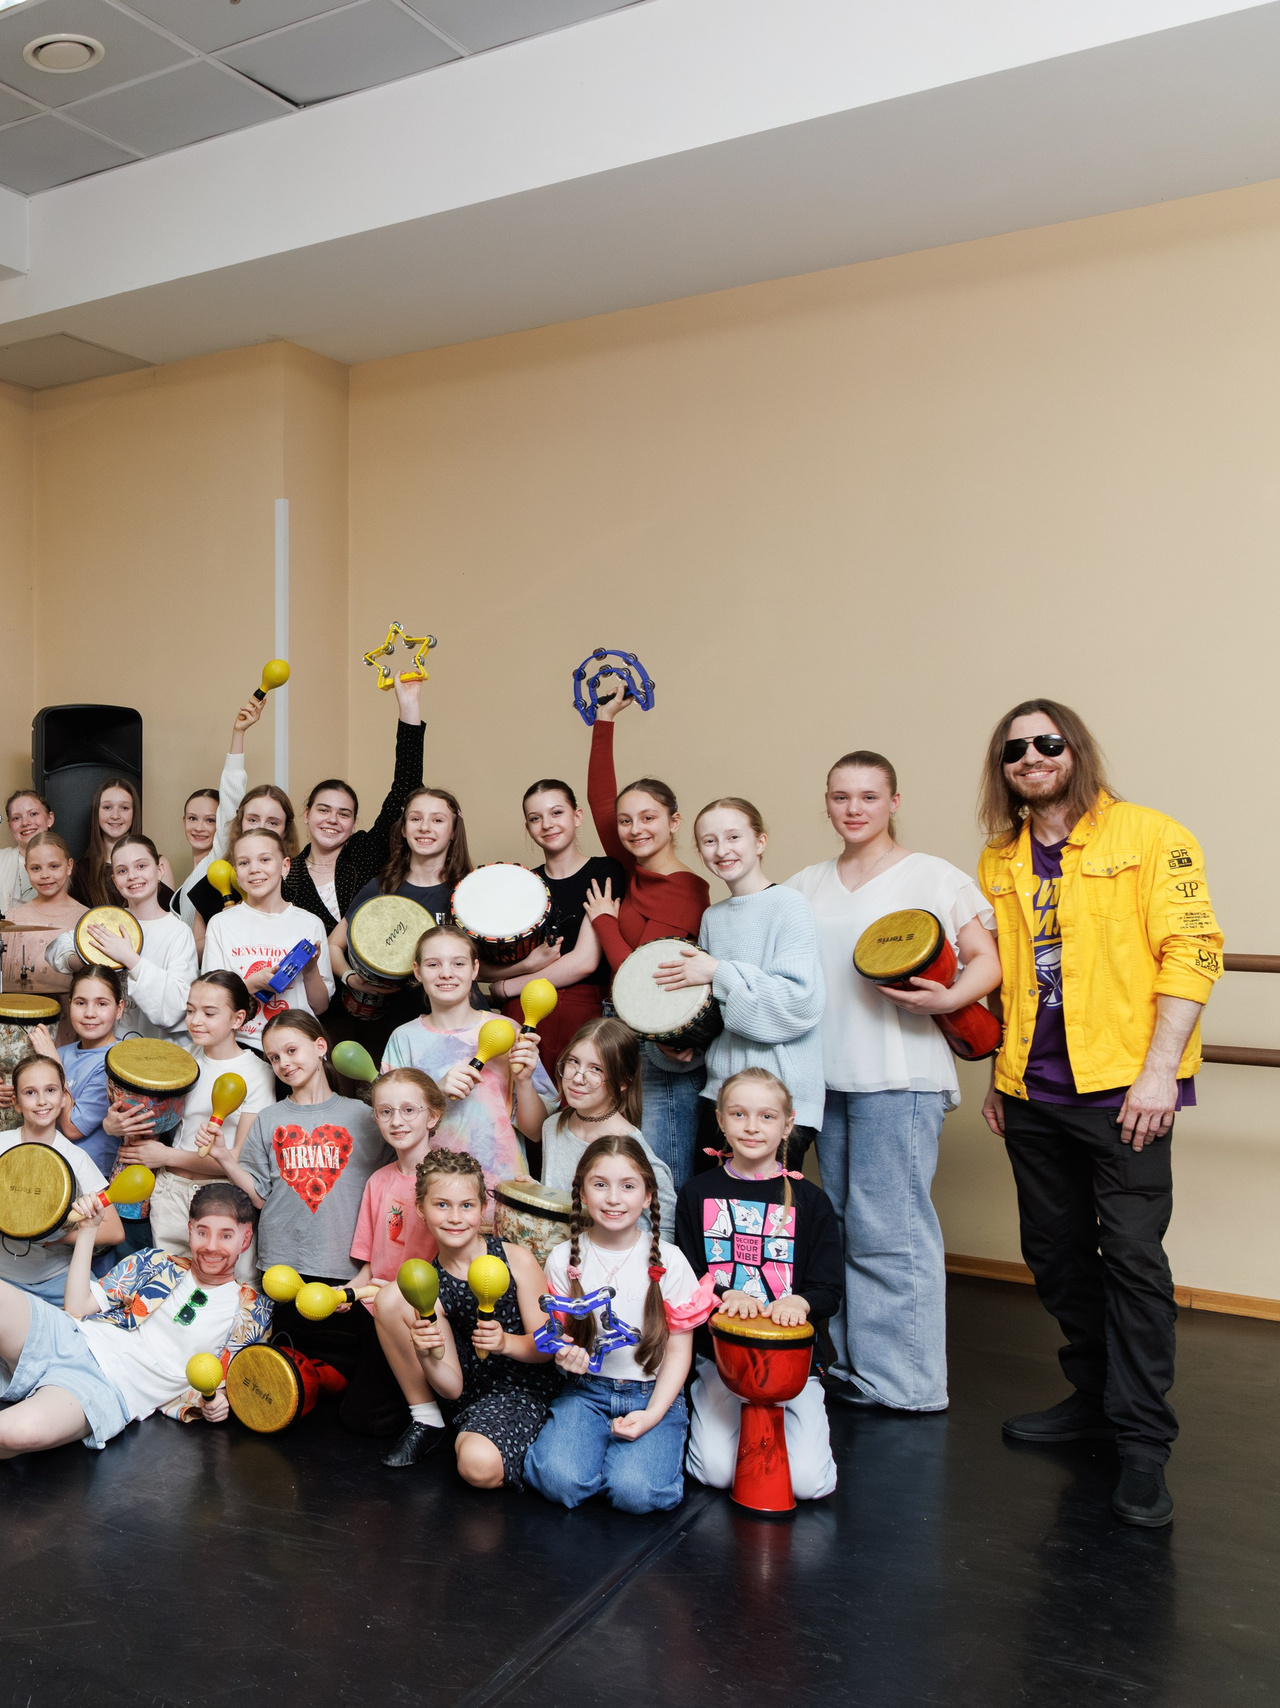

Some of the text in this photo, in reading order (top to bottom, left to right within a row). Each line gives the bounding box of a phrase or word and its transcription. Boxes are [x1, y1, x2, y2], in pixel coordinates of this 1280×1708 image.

[282, 1145, 340, 1170] NIRVANA
[735, 1236, 759, 1246] DECIDE
[736, 1243, 759, 1253] YOUR
[736, 1250, 759, 1262] VIBE
